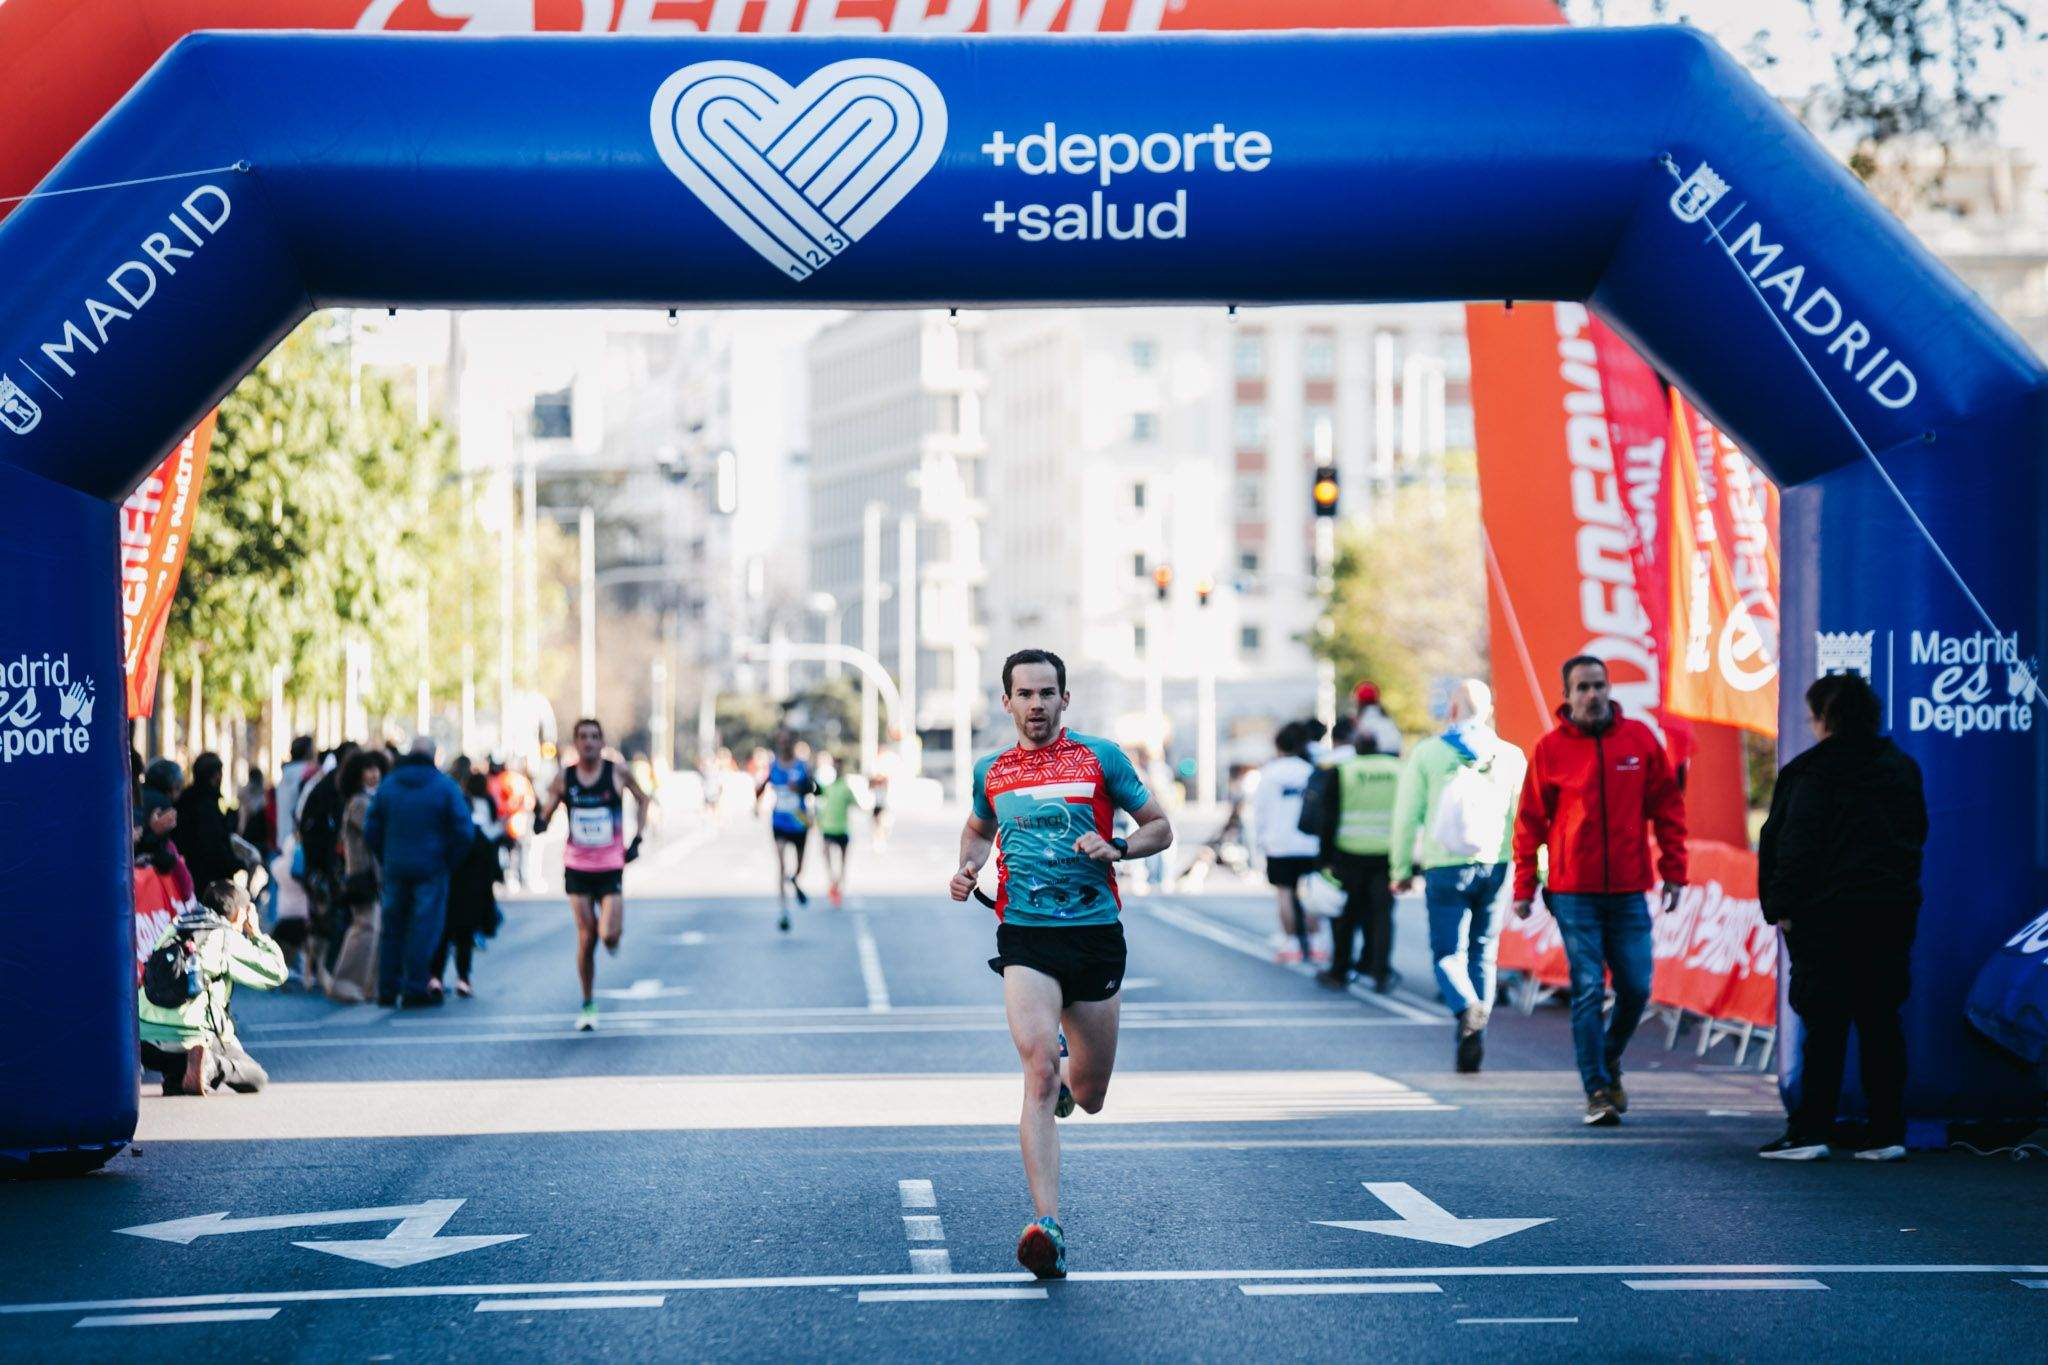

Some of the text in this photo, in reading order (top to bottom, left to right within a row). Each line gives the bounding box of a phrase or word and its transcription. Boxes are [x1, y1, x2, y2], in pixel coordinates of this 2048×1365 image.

[982, 122, 1272, 186] +deporte
[982, 190, 1187, 241] +salud
[41, 184, 232, 378] MADRID
[1728, 221, 1918, 410] MADRID
[1911, 630, 2018, 664] Madrid
[1932, 663, 1992, 703] es
[1910, 696, 2033, 737] Deporte
[0, 722, 90, 763] porte
